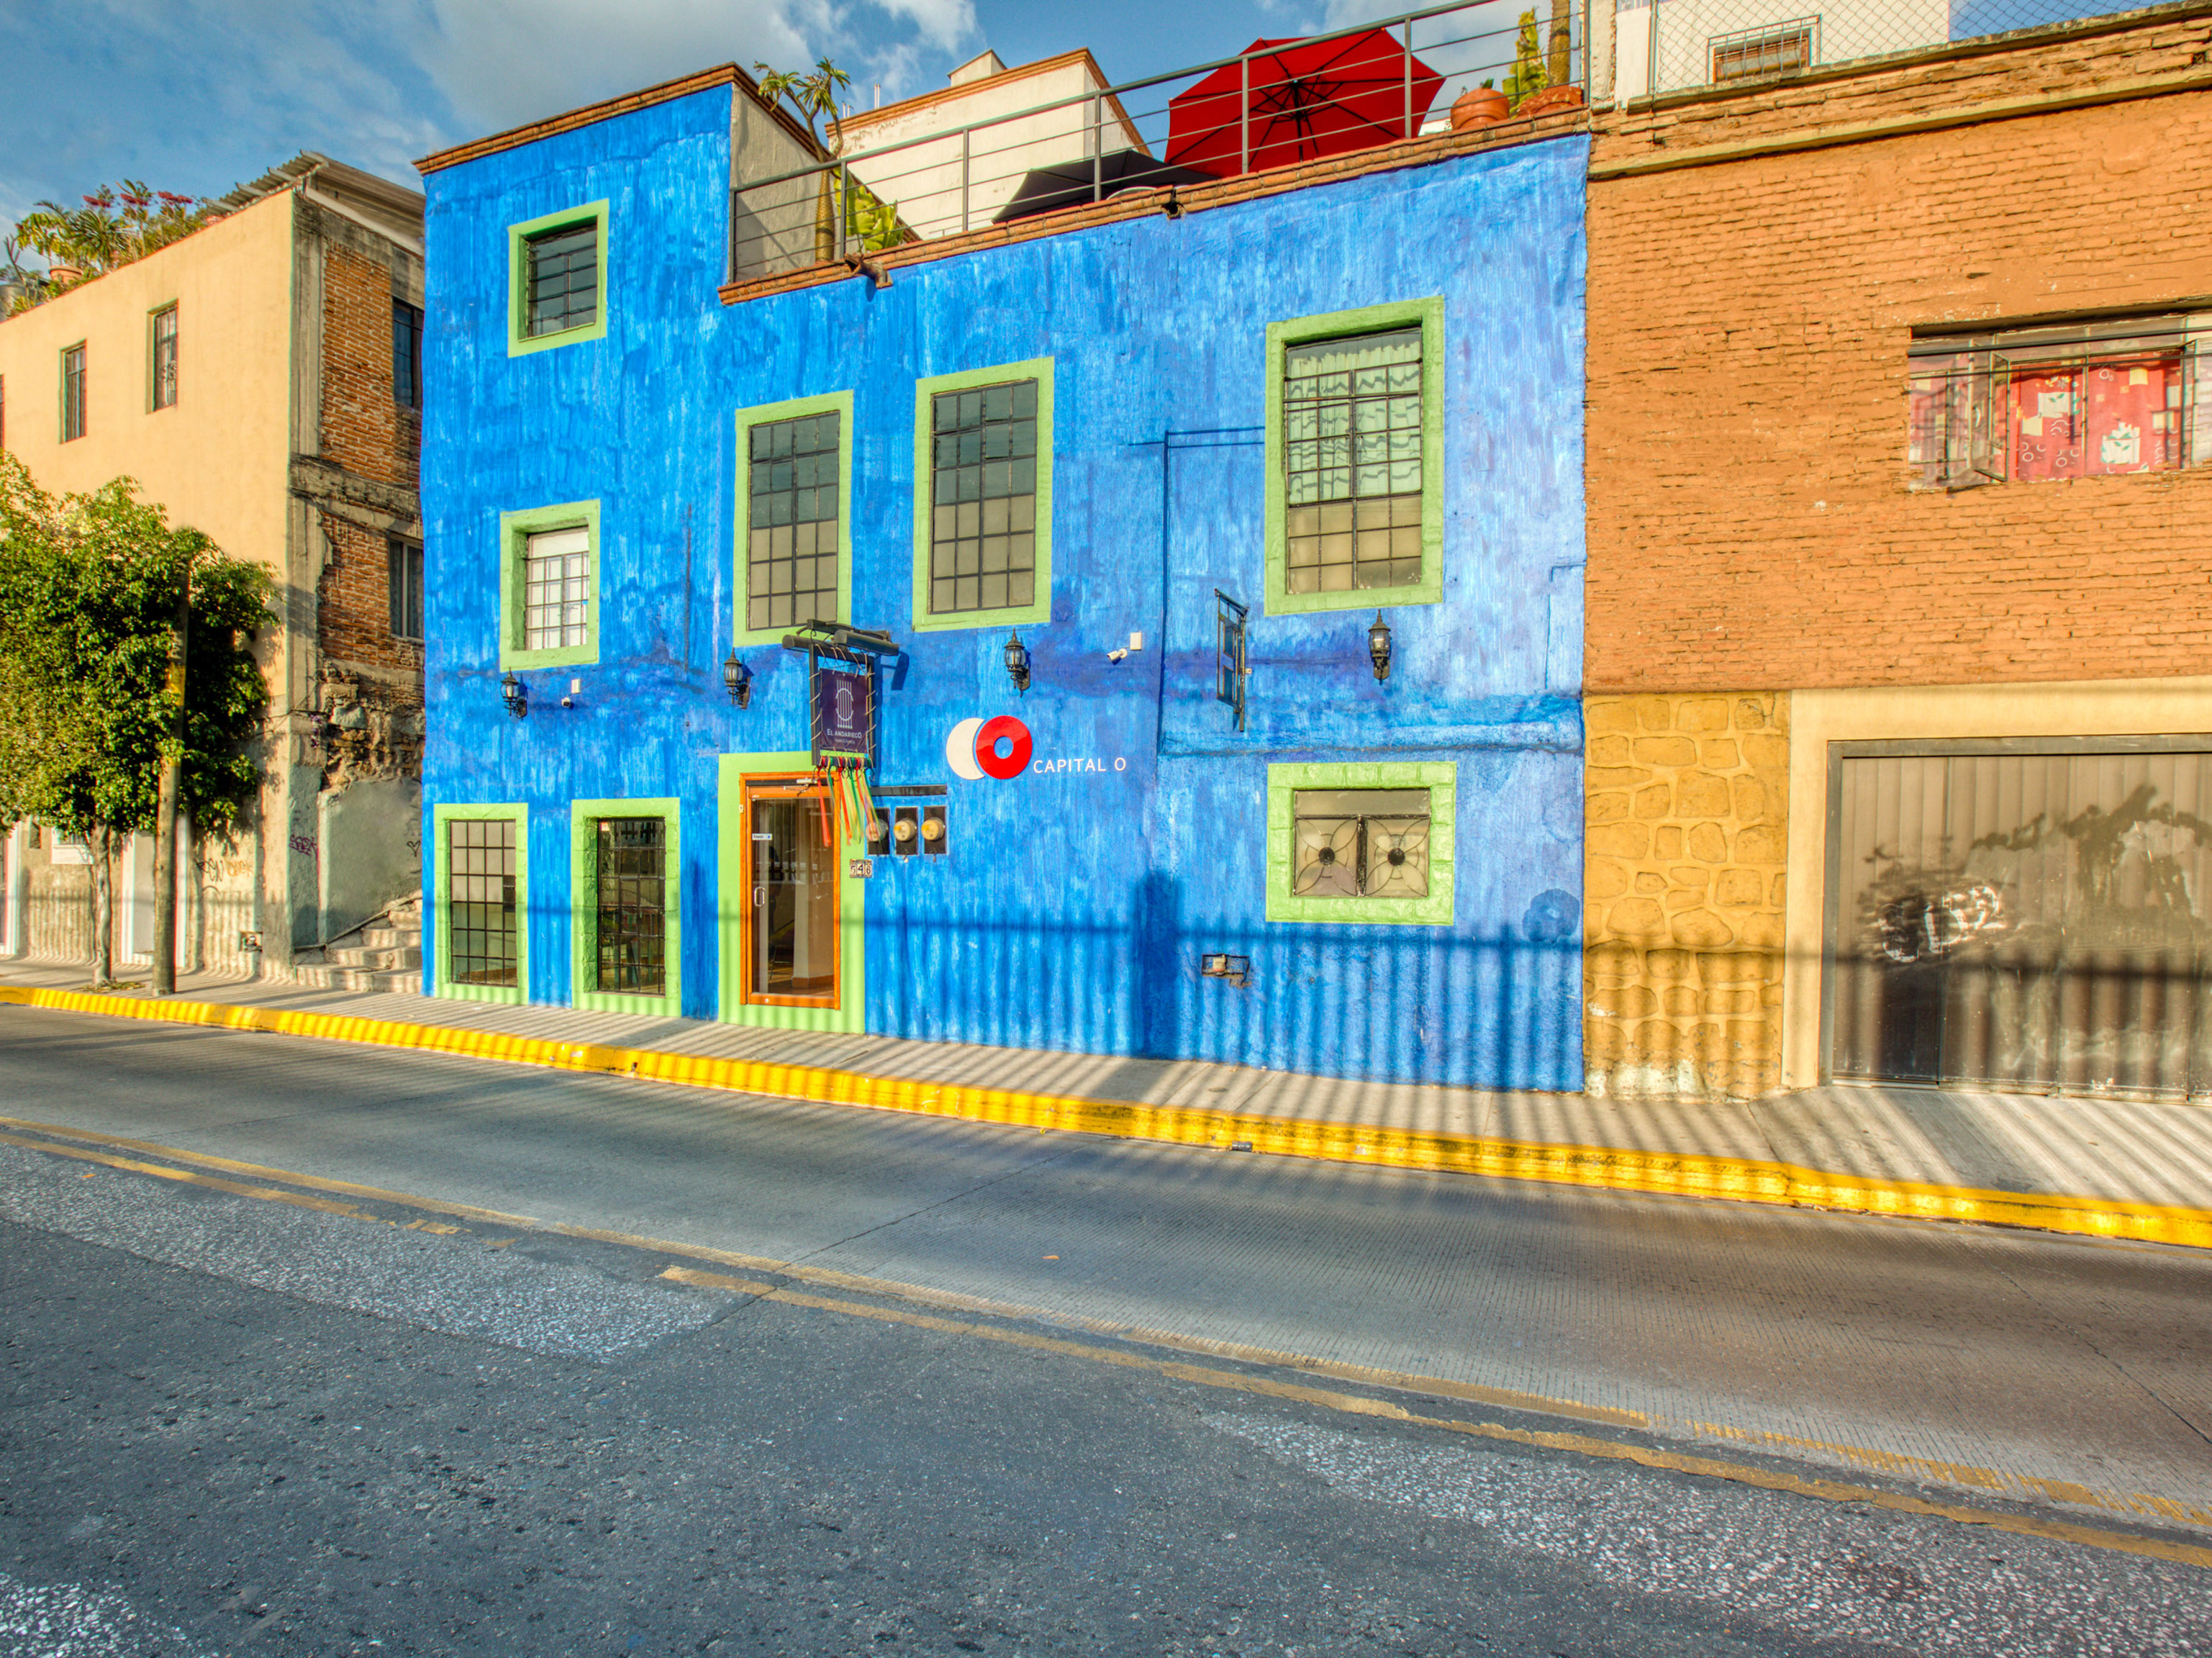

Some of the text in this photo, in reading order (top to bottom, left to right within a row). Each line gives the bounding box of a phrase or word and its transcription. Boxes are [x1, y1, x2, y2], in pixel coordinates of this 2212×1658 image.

[1033, 757, 1126, 774] CAPITAL O
[851, 864, 871, 875] 546
